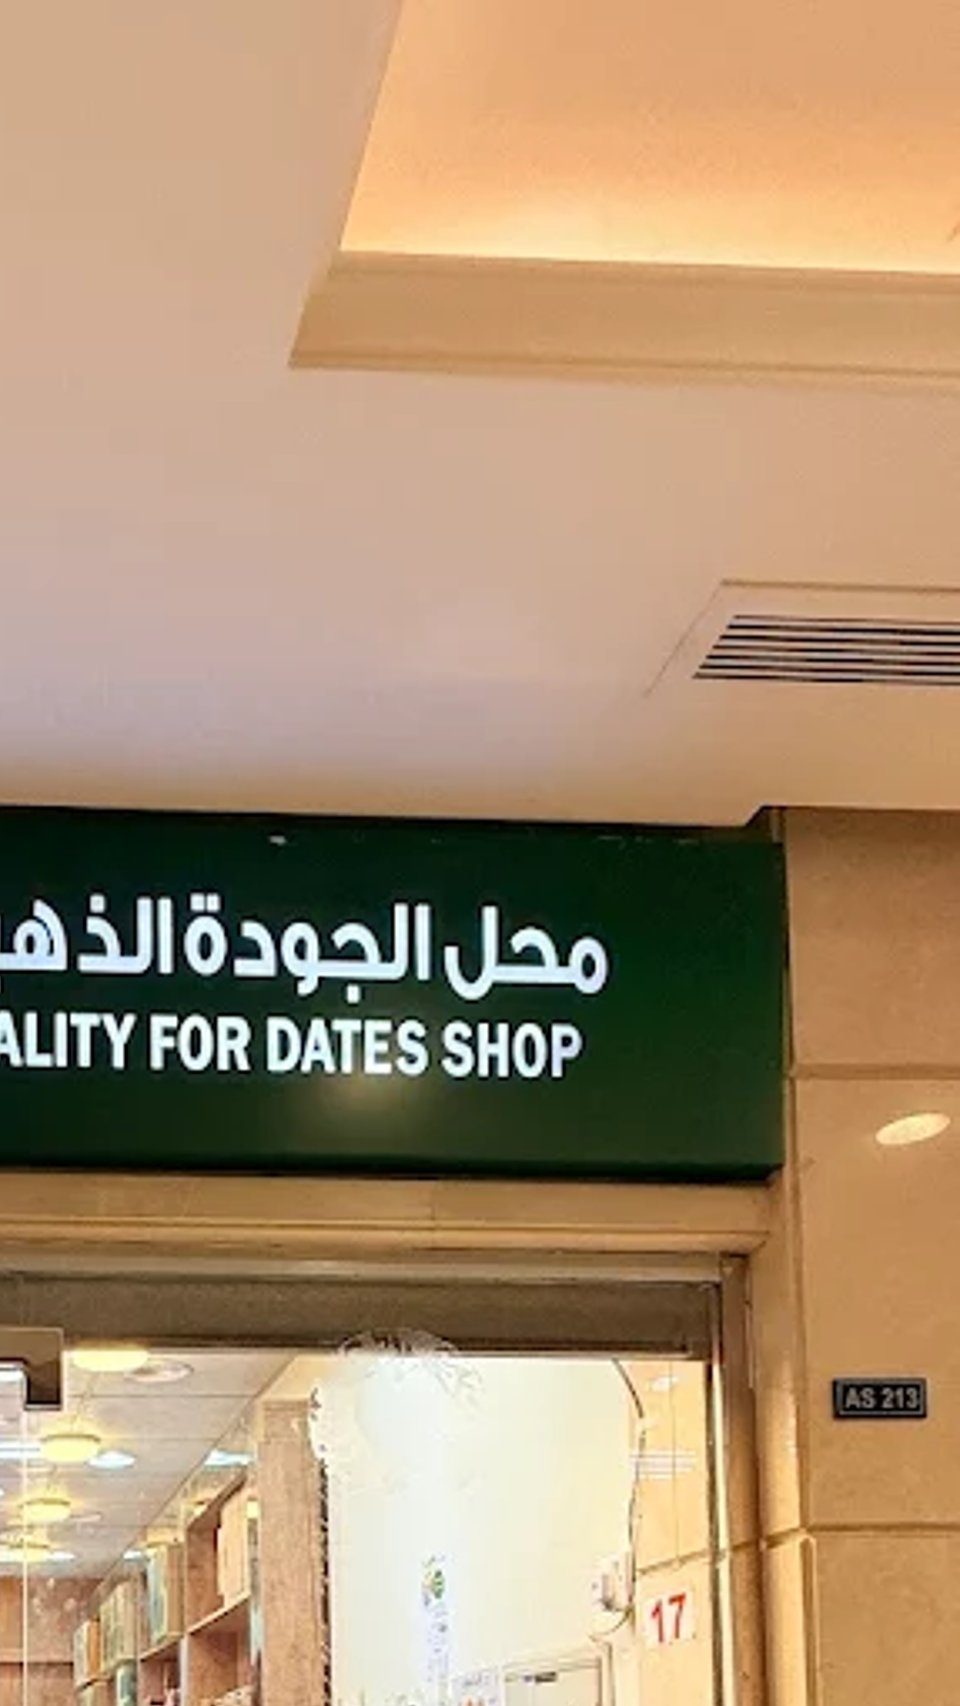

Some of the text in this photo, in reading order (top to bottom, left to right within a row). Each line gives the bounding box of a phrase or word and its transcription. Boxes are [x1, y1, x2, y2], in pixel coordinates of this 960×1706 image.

[183, 893, 431, 1002] الجودة
[443, 904, 608, 1000] محل
[149, 1013, 249, 1071] FOR
[265, 1017, 429, 1077] DATES
[441, 1021, 583, 1080] SHOP
[844, 1386, 919, 1409] AS 213
[649, 1593, 688, 1643] 17
